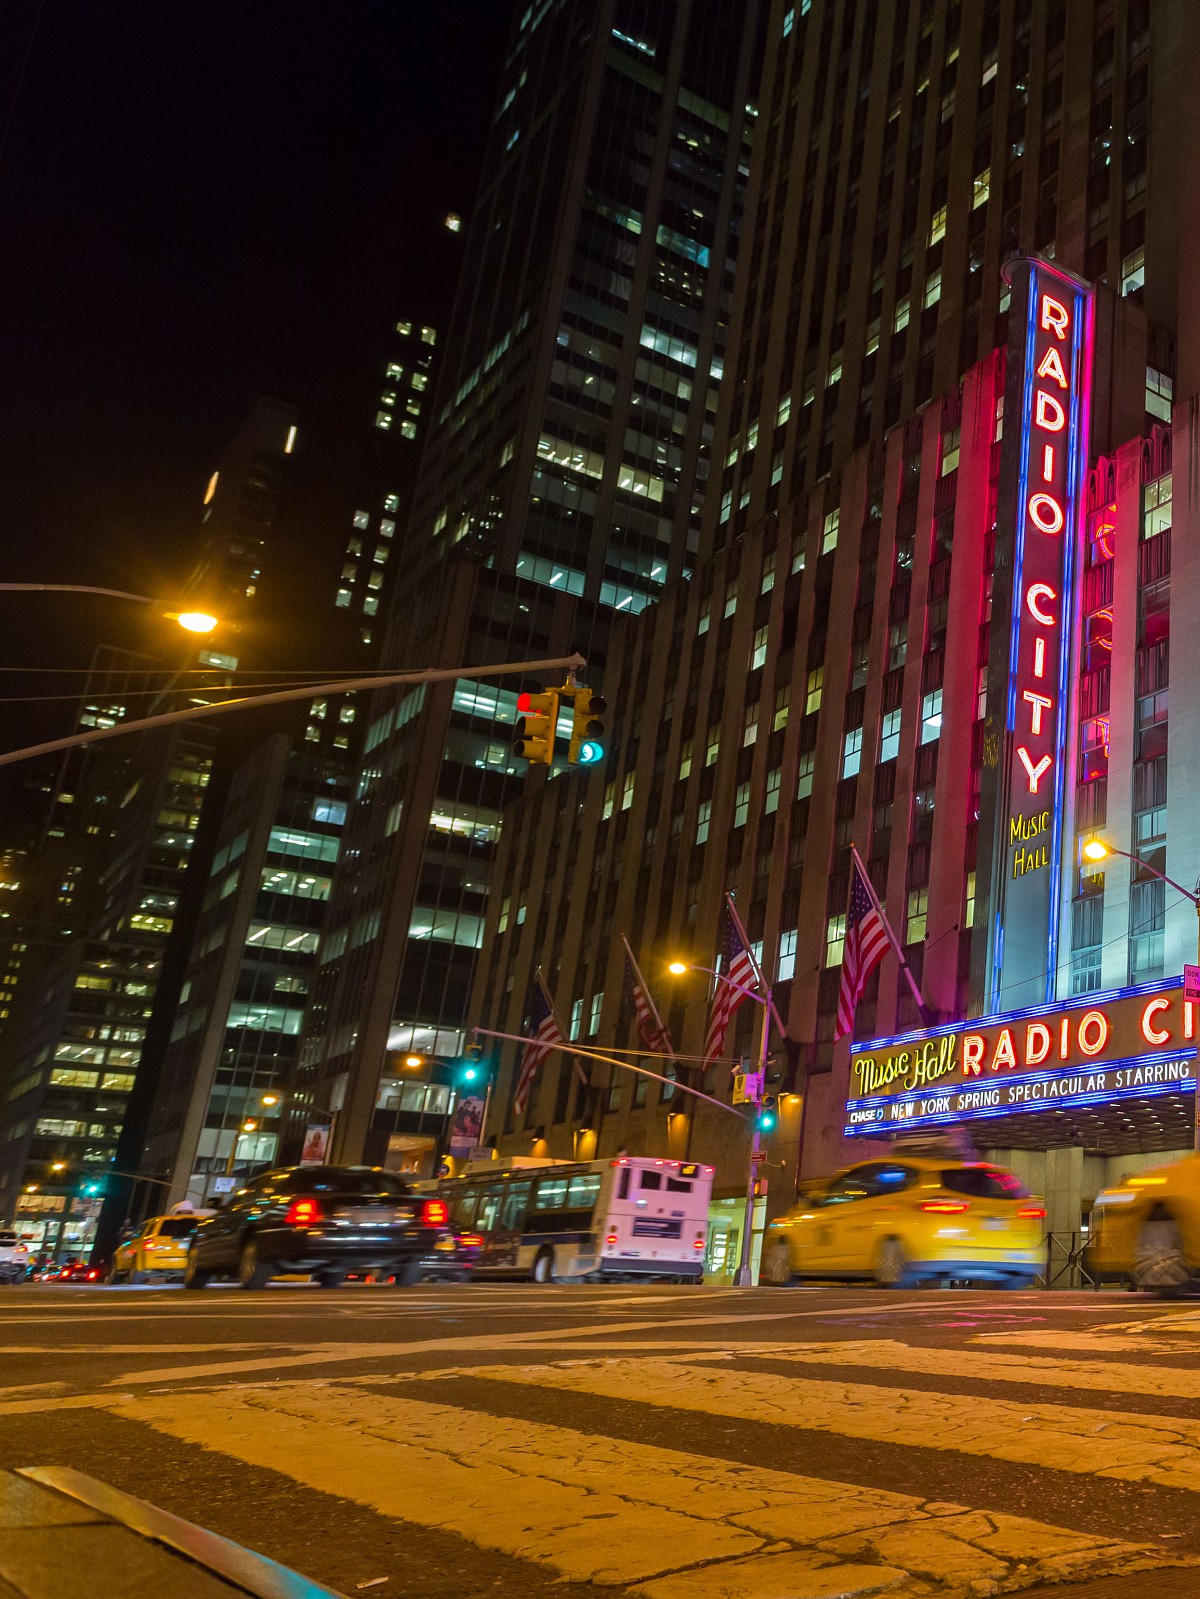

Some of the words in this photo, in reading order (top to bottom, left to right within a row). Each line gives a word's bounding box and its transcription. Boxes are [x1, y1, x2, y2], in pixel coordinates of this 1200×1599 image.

[1029, 295, 1069, 534] RADIO
[1017, 583, 1057, 794] CITY
[854, 1052, 909, 1096] Music
[903, 1034, 957, 1091] Hall
[962, 1010, 1109, 1076] RADIO
[850, 1109, 876, 1123] CHASE
[891, 1102, 915, 1120] NEW
[921, 1097, 950, 1115] YORK
[957, 1089, 1000, 1110] SPRING
[1008, 1073, 1106, 1103] SPECTACULAR
[1115, 1061, 1190, 1088] STARRING
